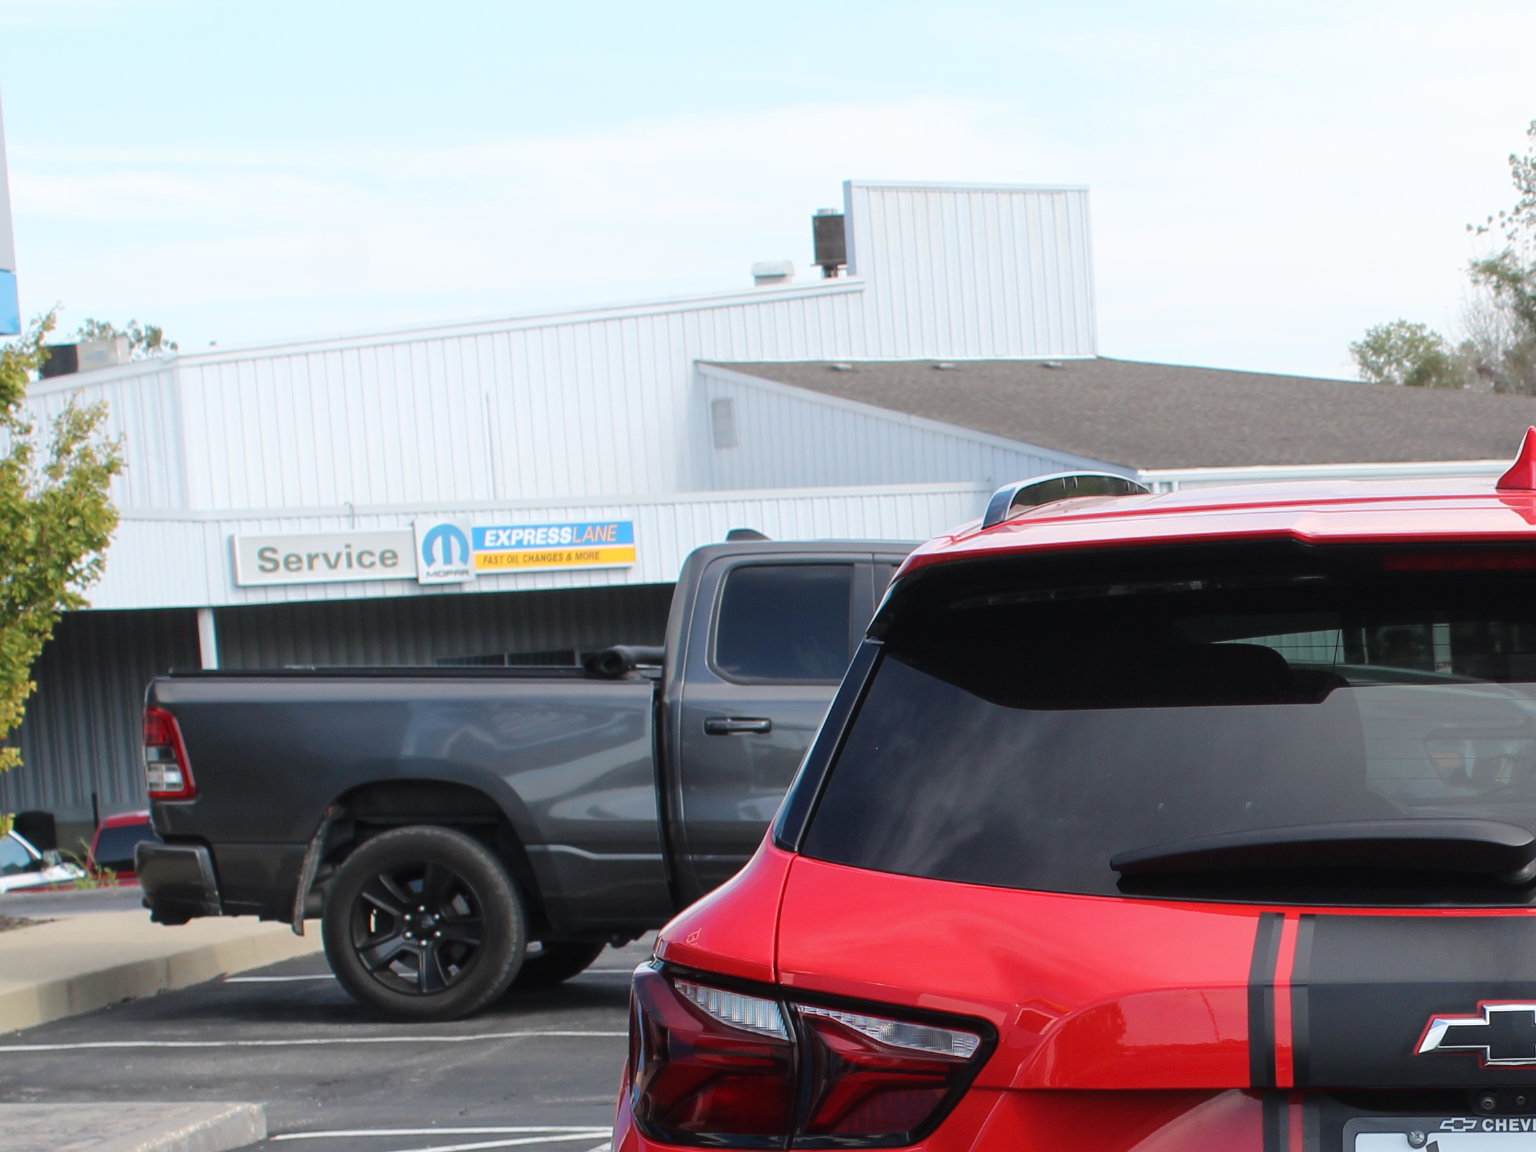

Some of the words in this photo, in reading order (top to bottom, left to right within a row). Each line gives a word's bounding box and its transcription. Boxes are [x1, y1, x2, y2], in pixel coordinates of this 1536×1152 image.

[257, 545, 399, 573] Service
[483, 553, 504, 565] FAST
[507, 553, 520, 564] OIL
[522, 551, 563, 563] CHANGES
[565, 551, 573, 561] &
[575, 550, 600, 561] MORE
[425, 569, 469, 578] MOPAR
